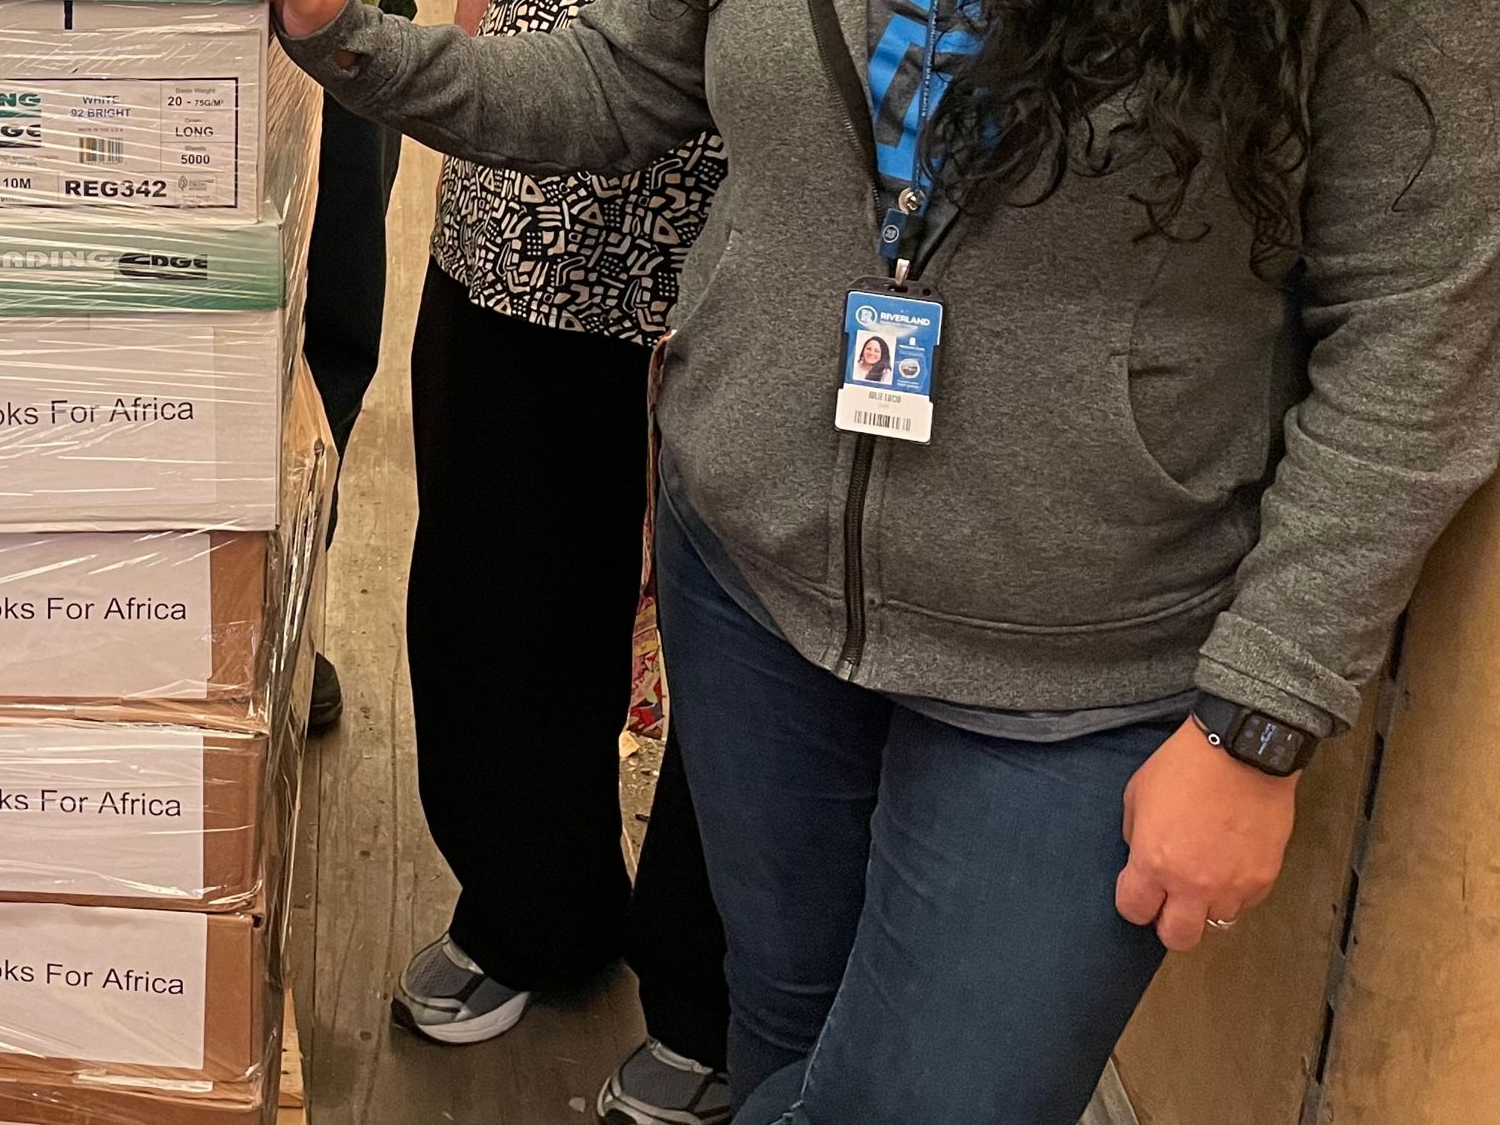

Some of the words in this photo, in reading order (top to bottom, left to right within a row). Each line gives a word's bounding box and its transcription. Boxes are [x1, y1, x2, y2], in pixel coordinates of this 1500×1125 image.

[82, 95, 120, 105] WHITE
[167, 96, 182, 106] 20
[70, 109, 84, 118] 92
[87, 108, 132, 118] BRIGHT
[175, 126, 214, 137] LONG
[181, 154, 210, 165] 5000
[3, 178, 31, 189] 10M
[64, 179, 167, 197] REG342
[118, 251, 208, 281] EDGE
[880, 312, 931, 327] RIVERLAND
[51, 400, 97, 424] For
[108, 397, 195, 423] Africa
[47, 597, 94, 620] For
[103, 596, 188, 621] Africa
[40, 789, 89, 813] For
[98, 791, 182, 817] Africa
[46, 962, 93, 988] For
[102, 968, 184, 996] Africa
